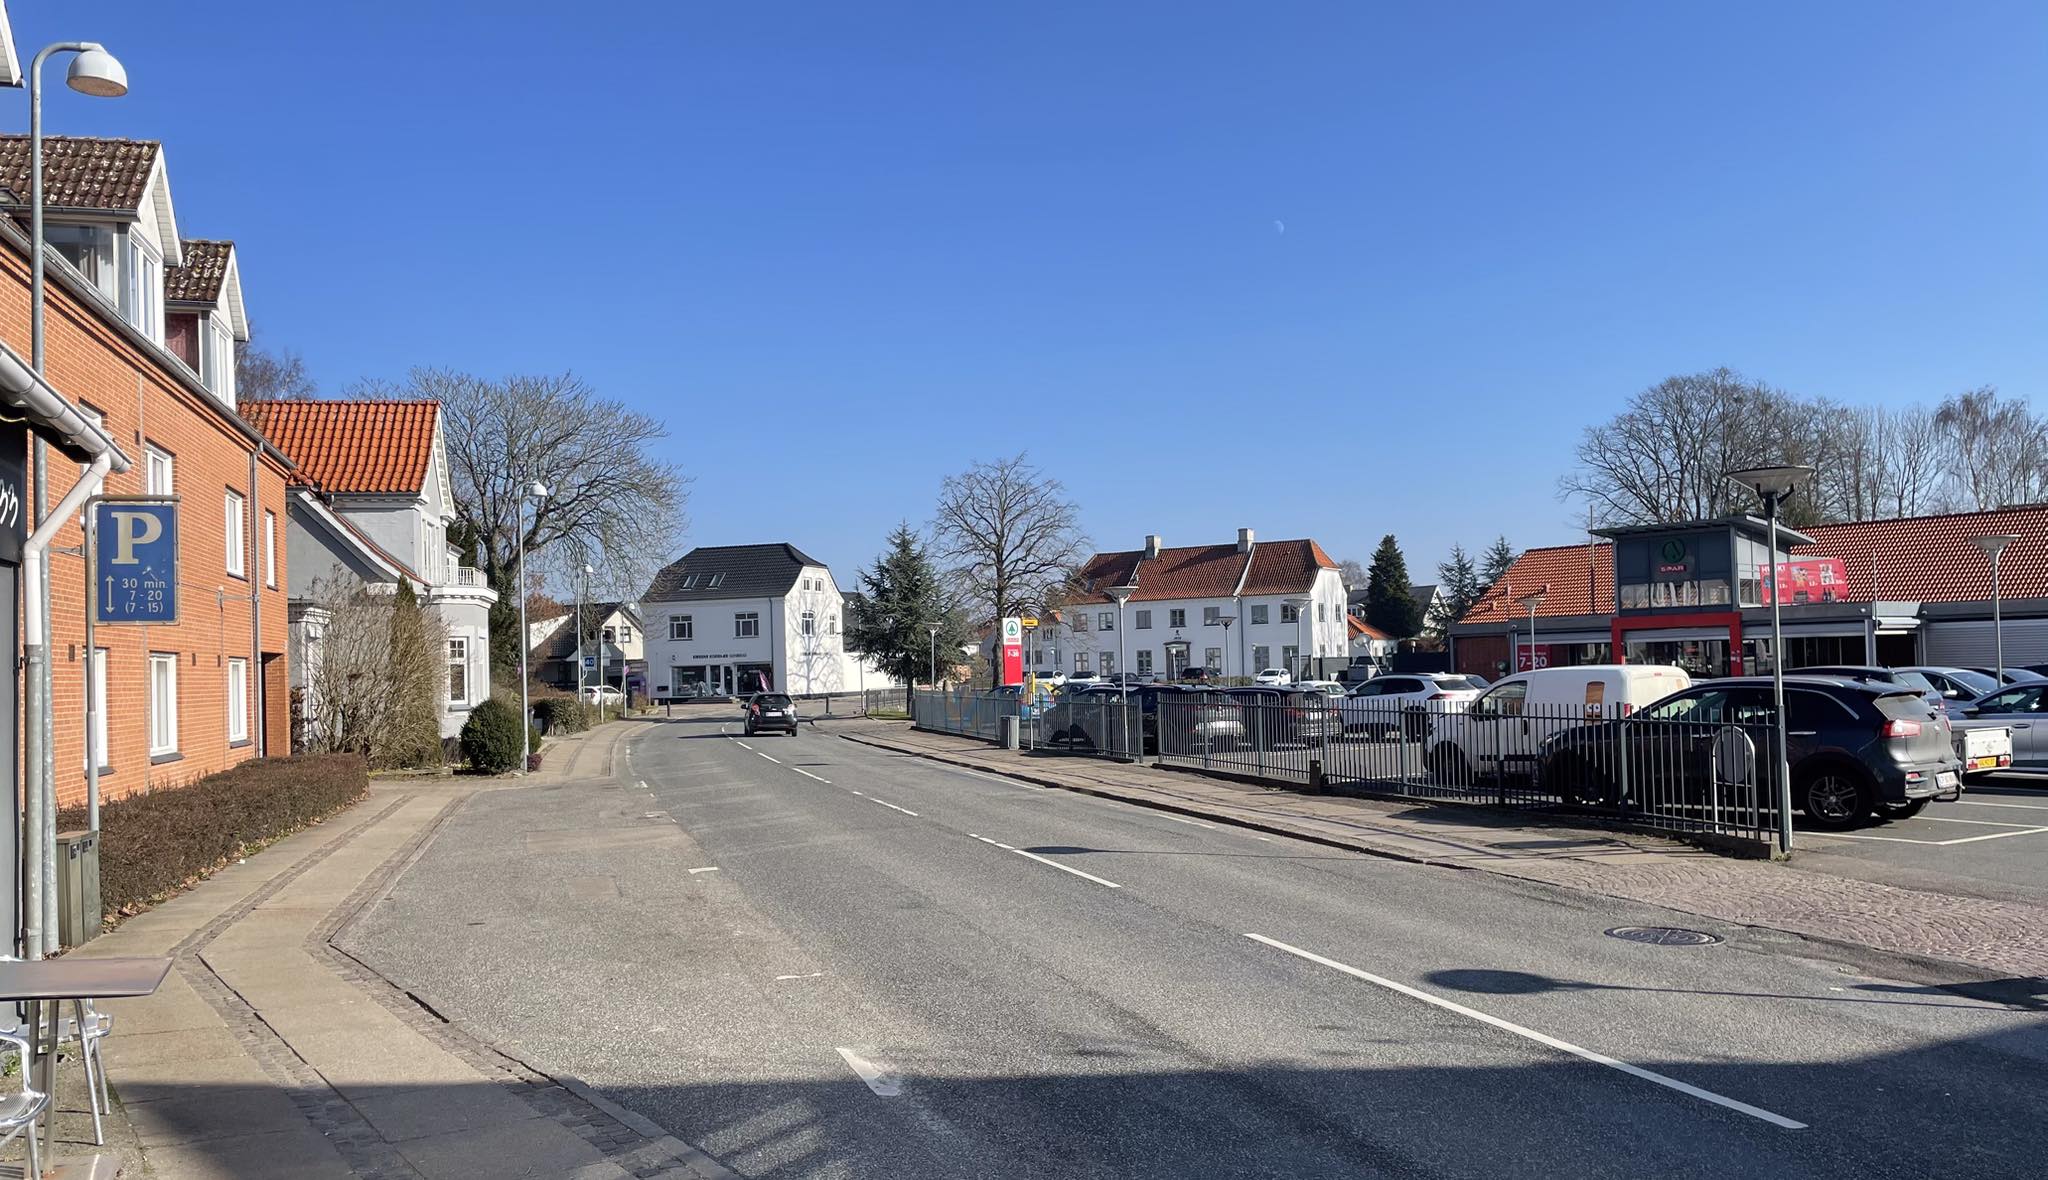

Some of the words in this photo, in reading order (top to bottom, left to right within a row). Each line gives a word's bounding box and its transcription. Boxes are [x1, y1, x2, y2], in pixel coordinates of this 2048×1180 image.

[111, 512, 163, 564] P
[121, 578, 138, 589] 30
[129, 590, 136, 601] 7
[147, 590, 163, 601] 20
[125, 602, 136, 614] (7
[147, 602, 164, 614] 15)
[584, 658, 594, 666] 40
[1519, 656, 1548, 668] 7-20
